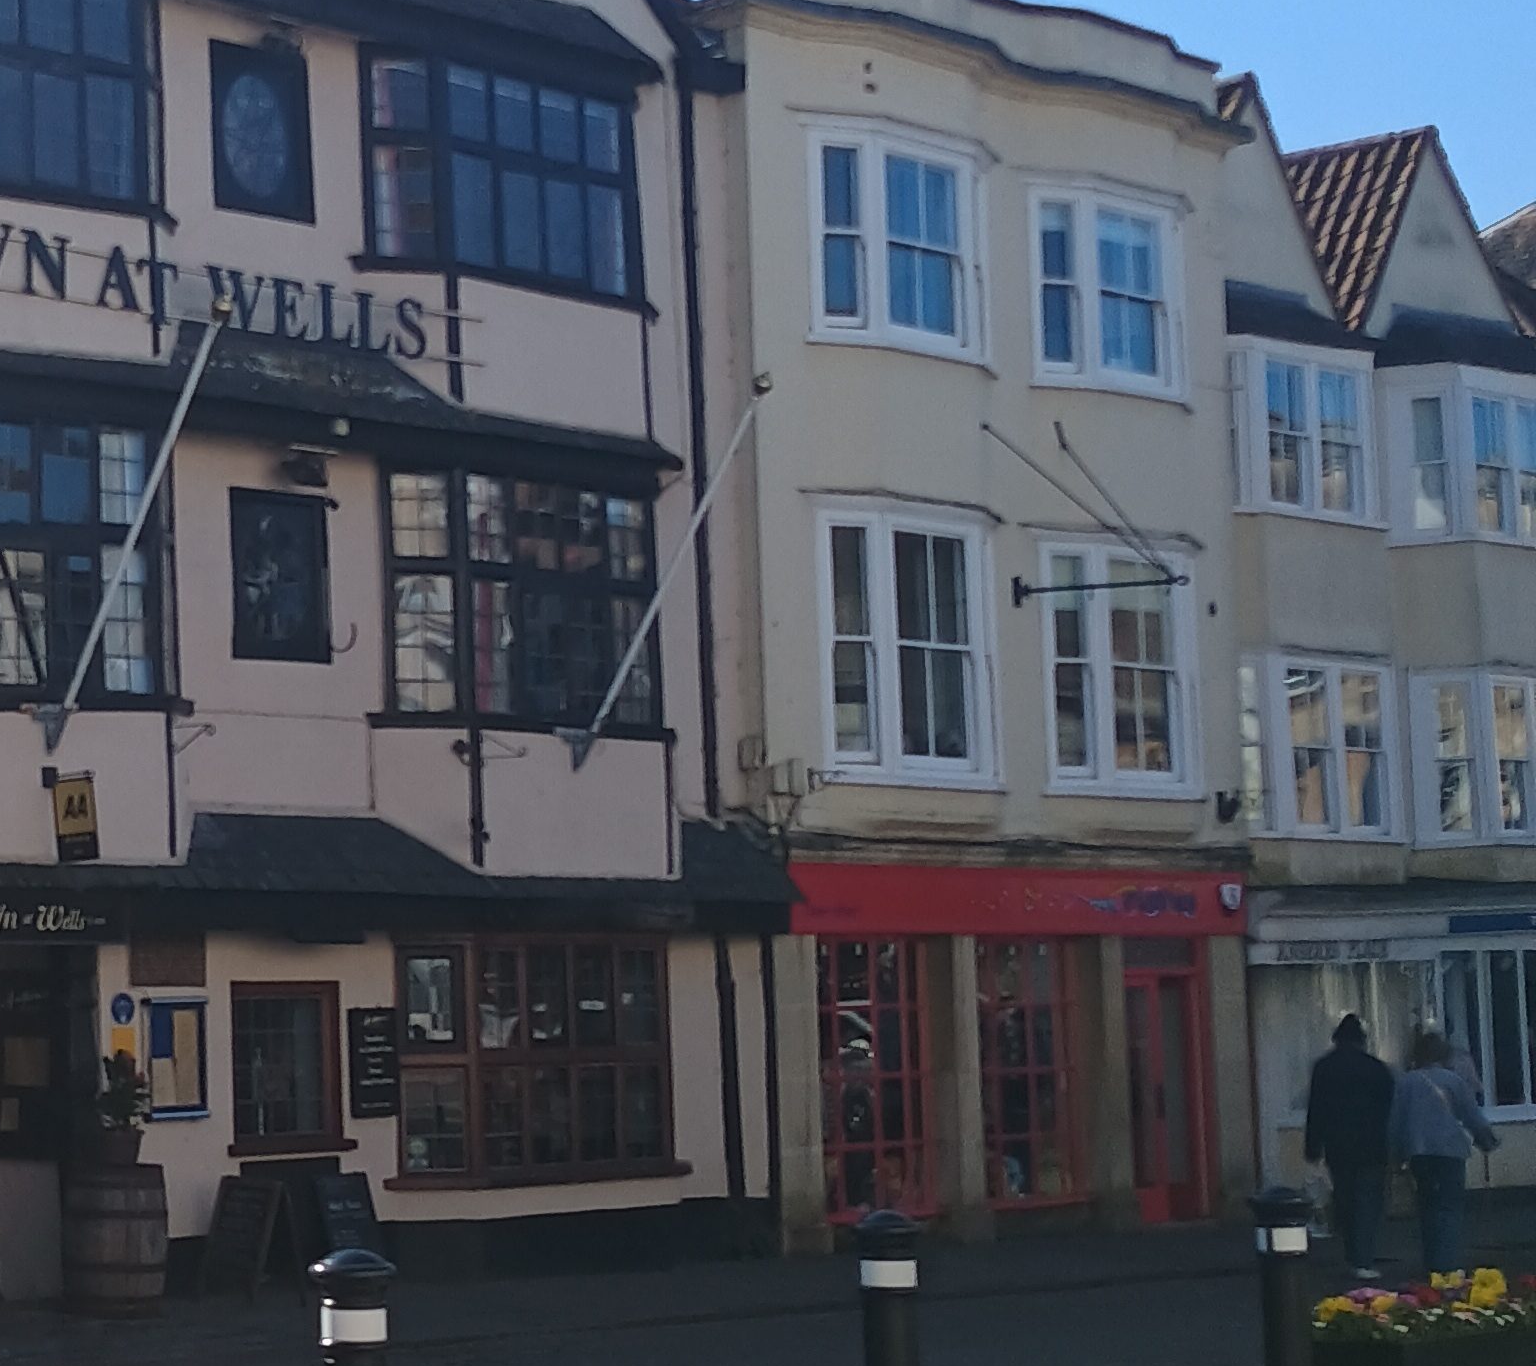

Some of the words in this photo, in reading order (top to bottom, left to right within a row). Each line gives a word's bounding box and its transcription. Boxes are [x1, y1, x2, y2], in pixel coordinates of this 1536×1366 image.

[93, 242, 179, 328] AT
[205, 264, 428, 361] WELLS
[63, 794, 89, 820] AA
[36, 904, 86, 932] Wells
